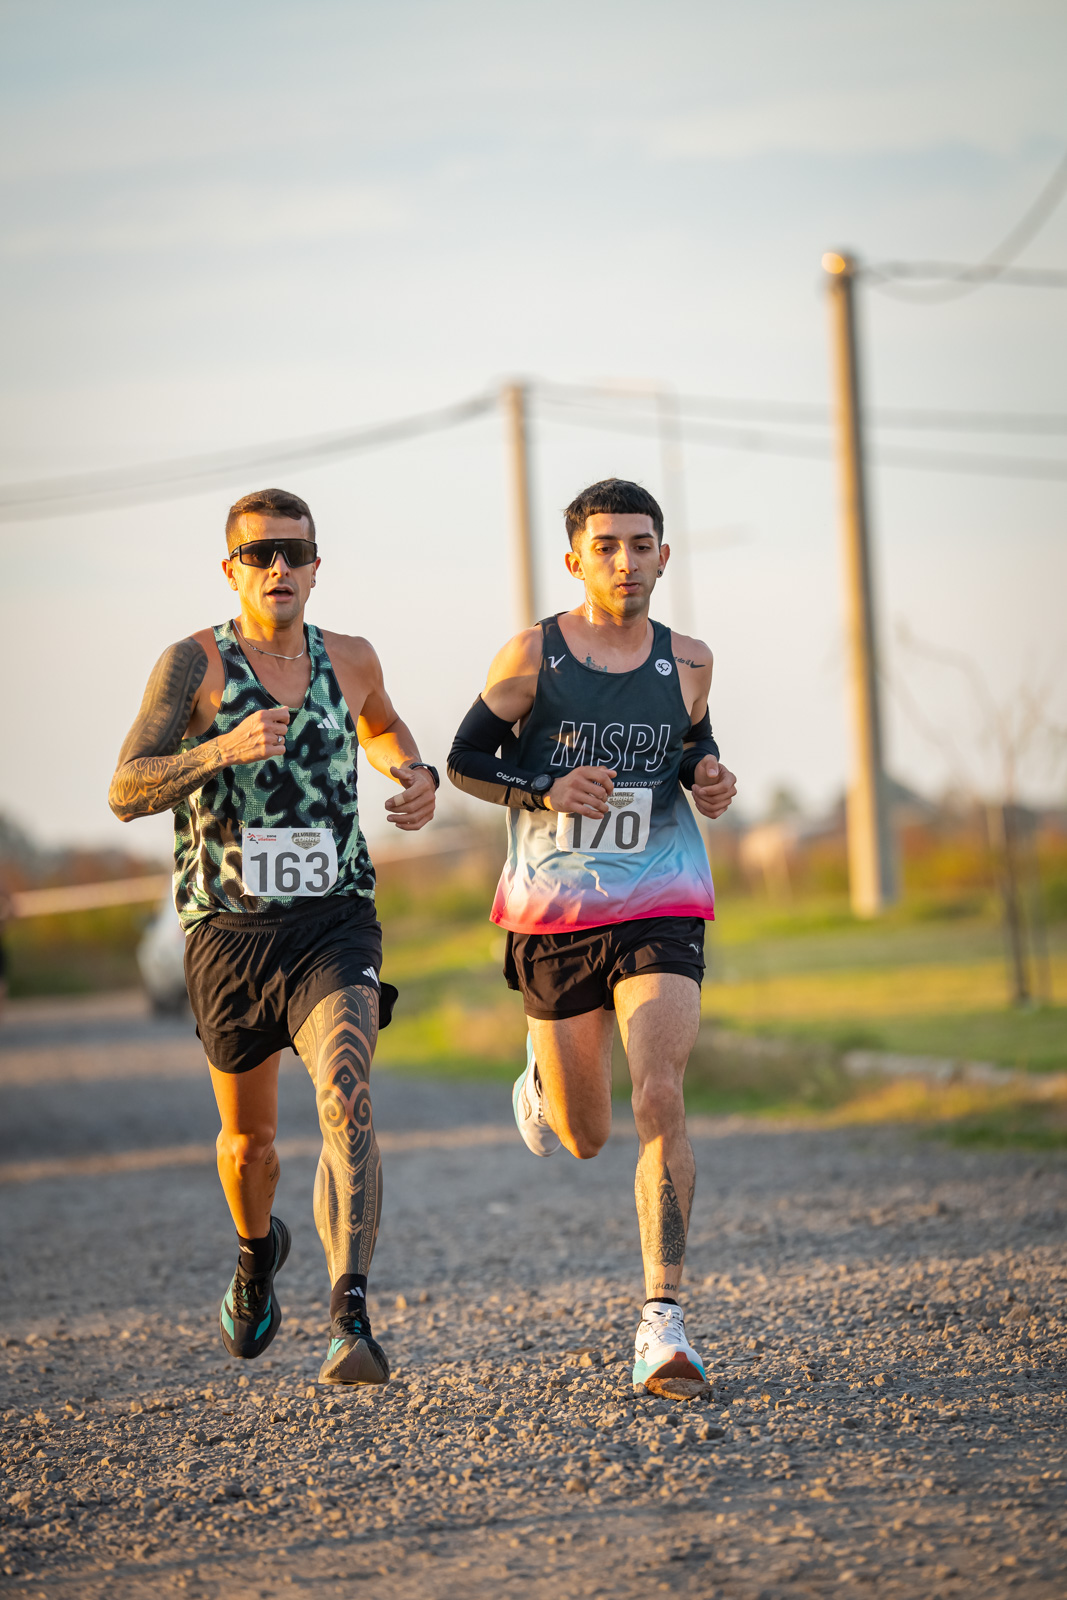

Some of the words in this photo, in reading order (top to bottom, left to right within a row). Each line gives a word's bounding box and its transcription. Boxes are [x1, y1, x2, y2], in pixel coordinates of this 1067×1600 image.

[550, 720, 671, 772] MSPJ
[566, 810, 641, 850] 170
[250, 851, 330, 893] 163
